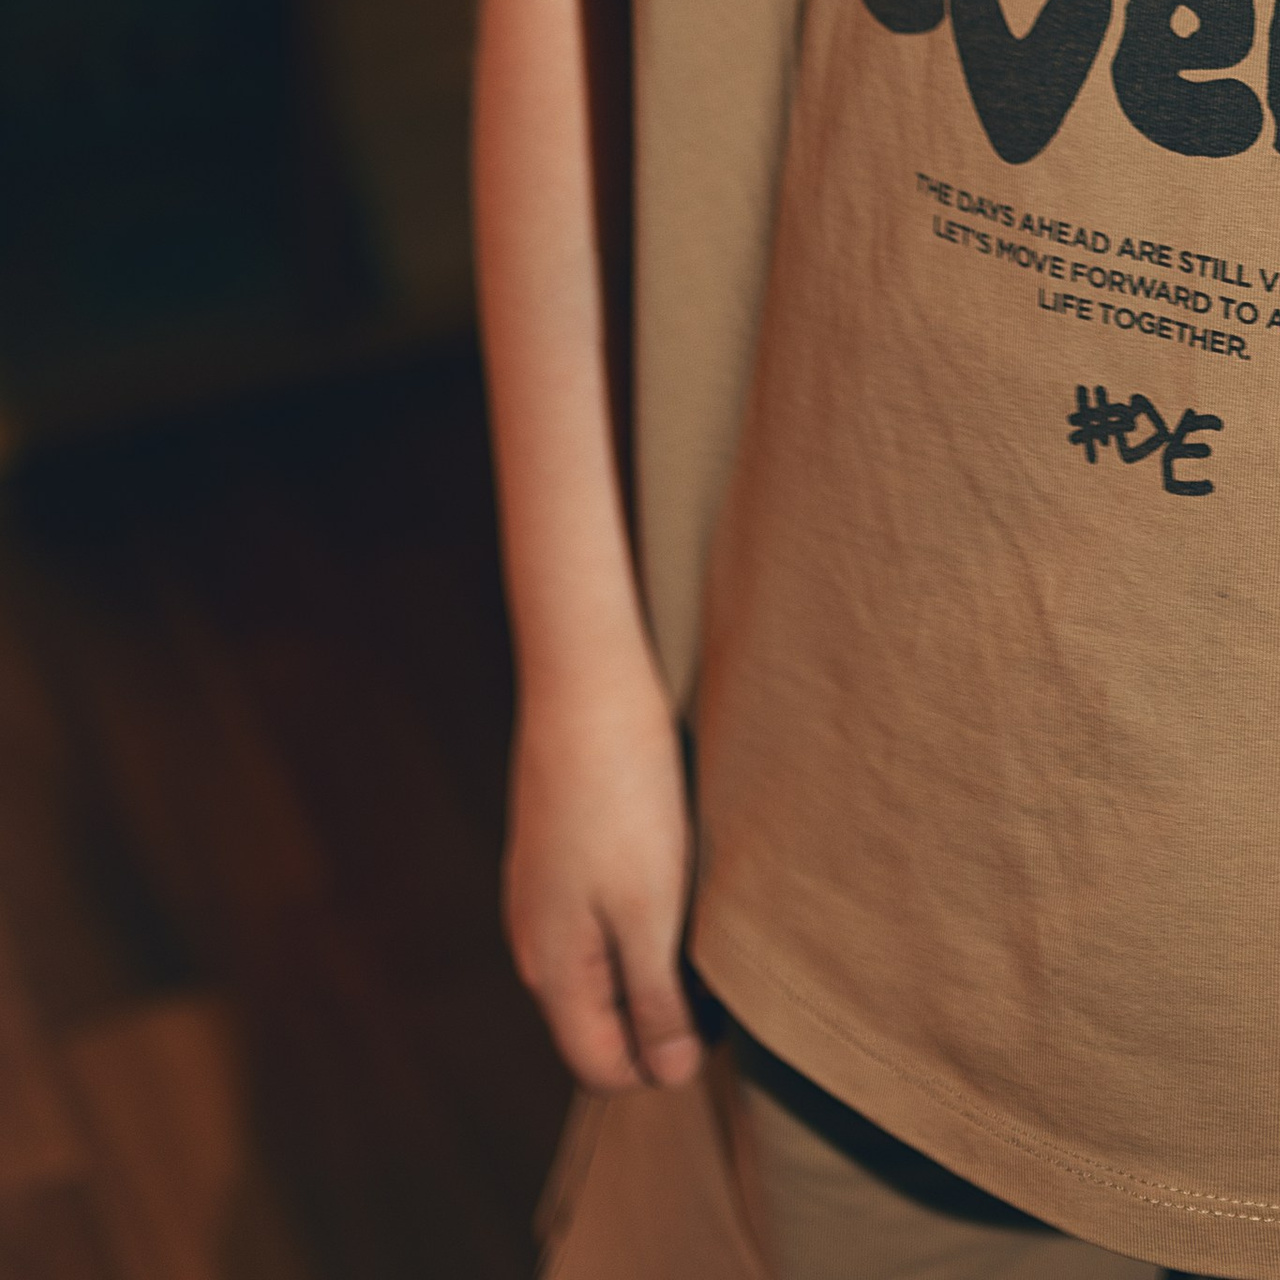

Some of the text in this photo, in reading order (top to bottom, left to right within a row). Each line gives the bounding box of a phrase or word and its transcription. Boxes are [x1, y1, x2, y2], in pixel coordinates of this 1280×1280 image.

[915, 171, 952, 207] THE
[955, 190, 1016, 228] DAYS
[1018, 212, 1111, 255] AHEAD
[1116, 236, 1174, 269] ARE
[1178, 250, 1252, 288] STILL
[932, 213, 992, 255] LET'S
[996, 236, 1065, 280] MOVE
[1069, 260, 1213, 316] FORWARD
[1219, 294, 1260, 326] TO
[1038, 286, 1252, 361] LIFE TOGETHER.
